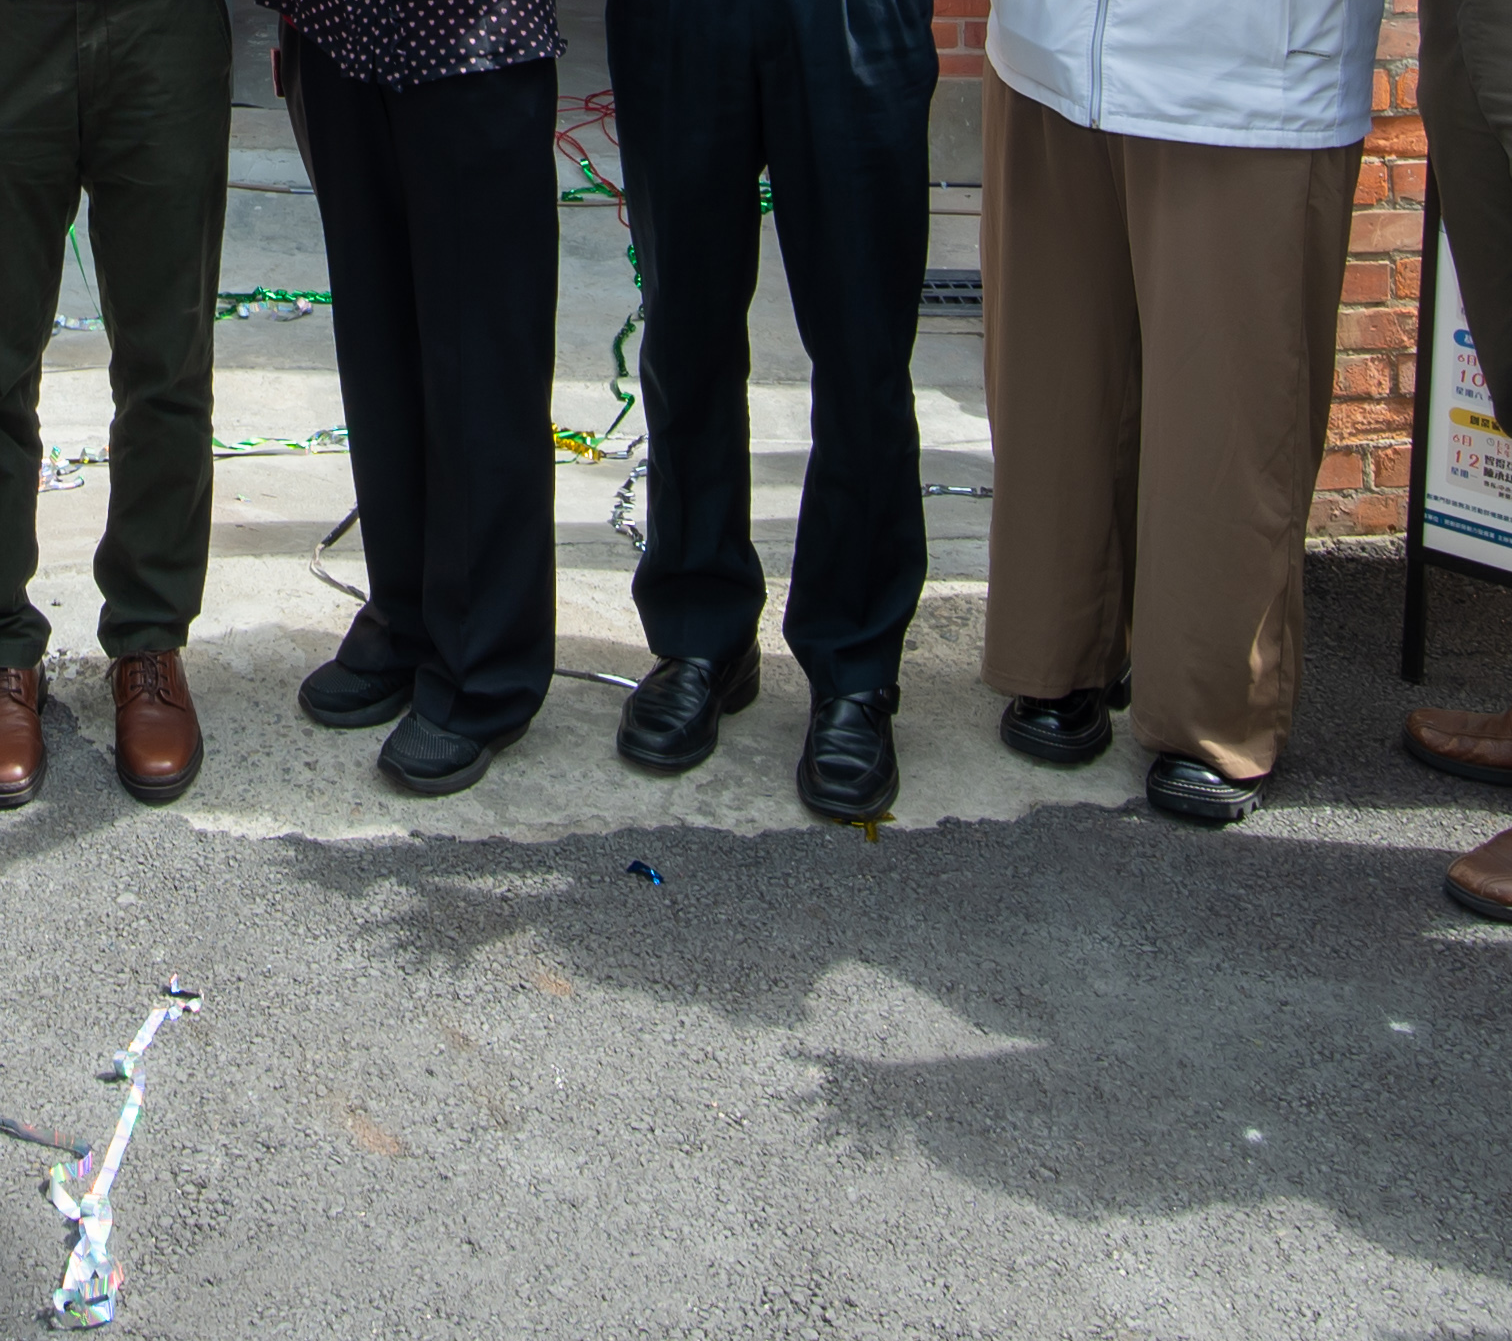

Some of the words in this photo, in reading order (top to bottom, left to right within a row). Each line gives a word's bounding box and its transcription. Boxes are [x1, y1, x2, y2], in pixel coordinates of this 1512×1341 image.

[1459, 369, 1487, 389] 10
[1452, 433, 1473, 448] 6月
[1454, 448, 1481, 470] 12
